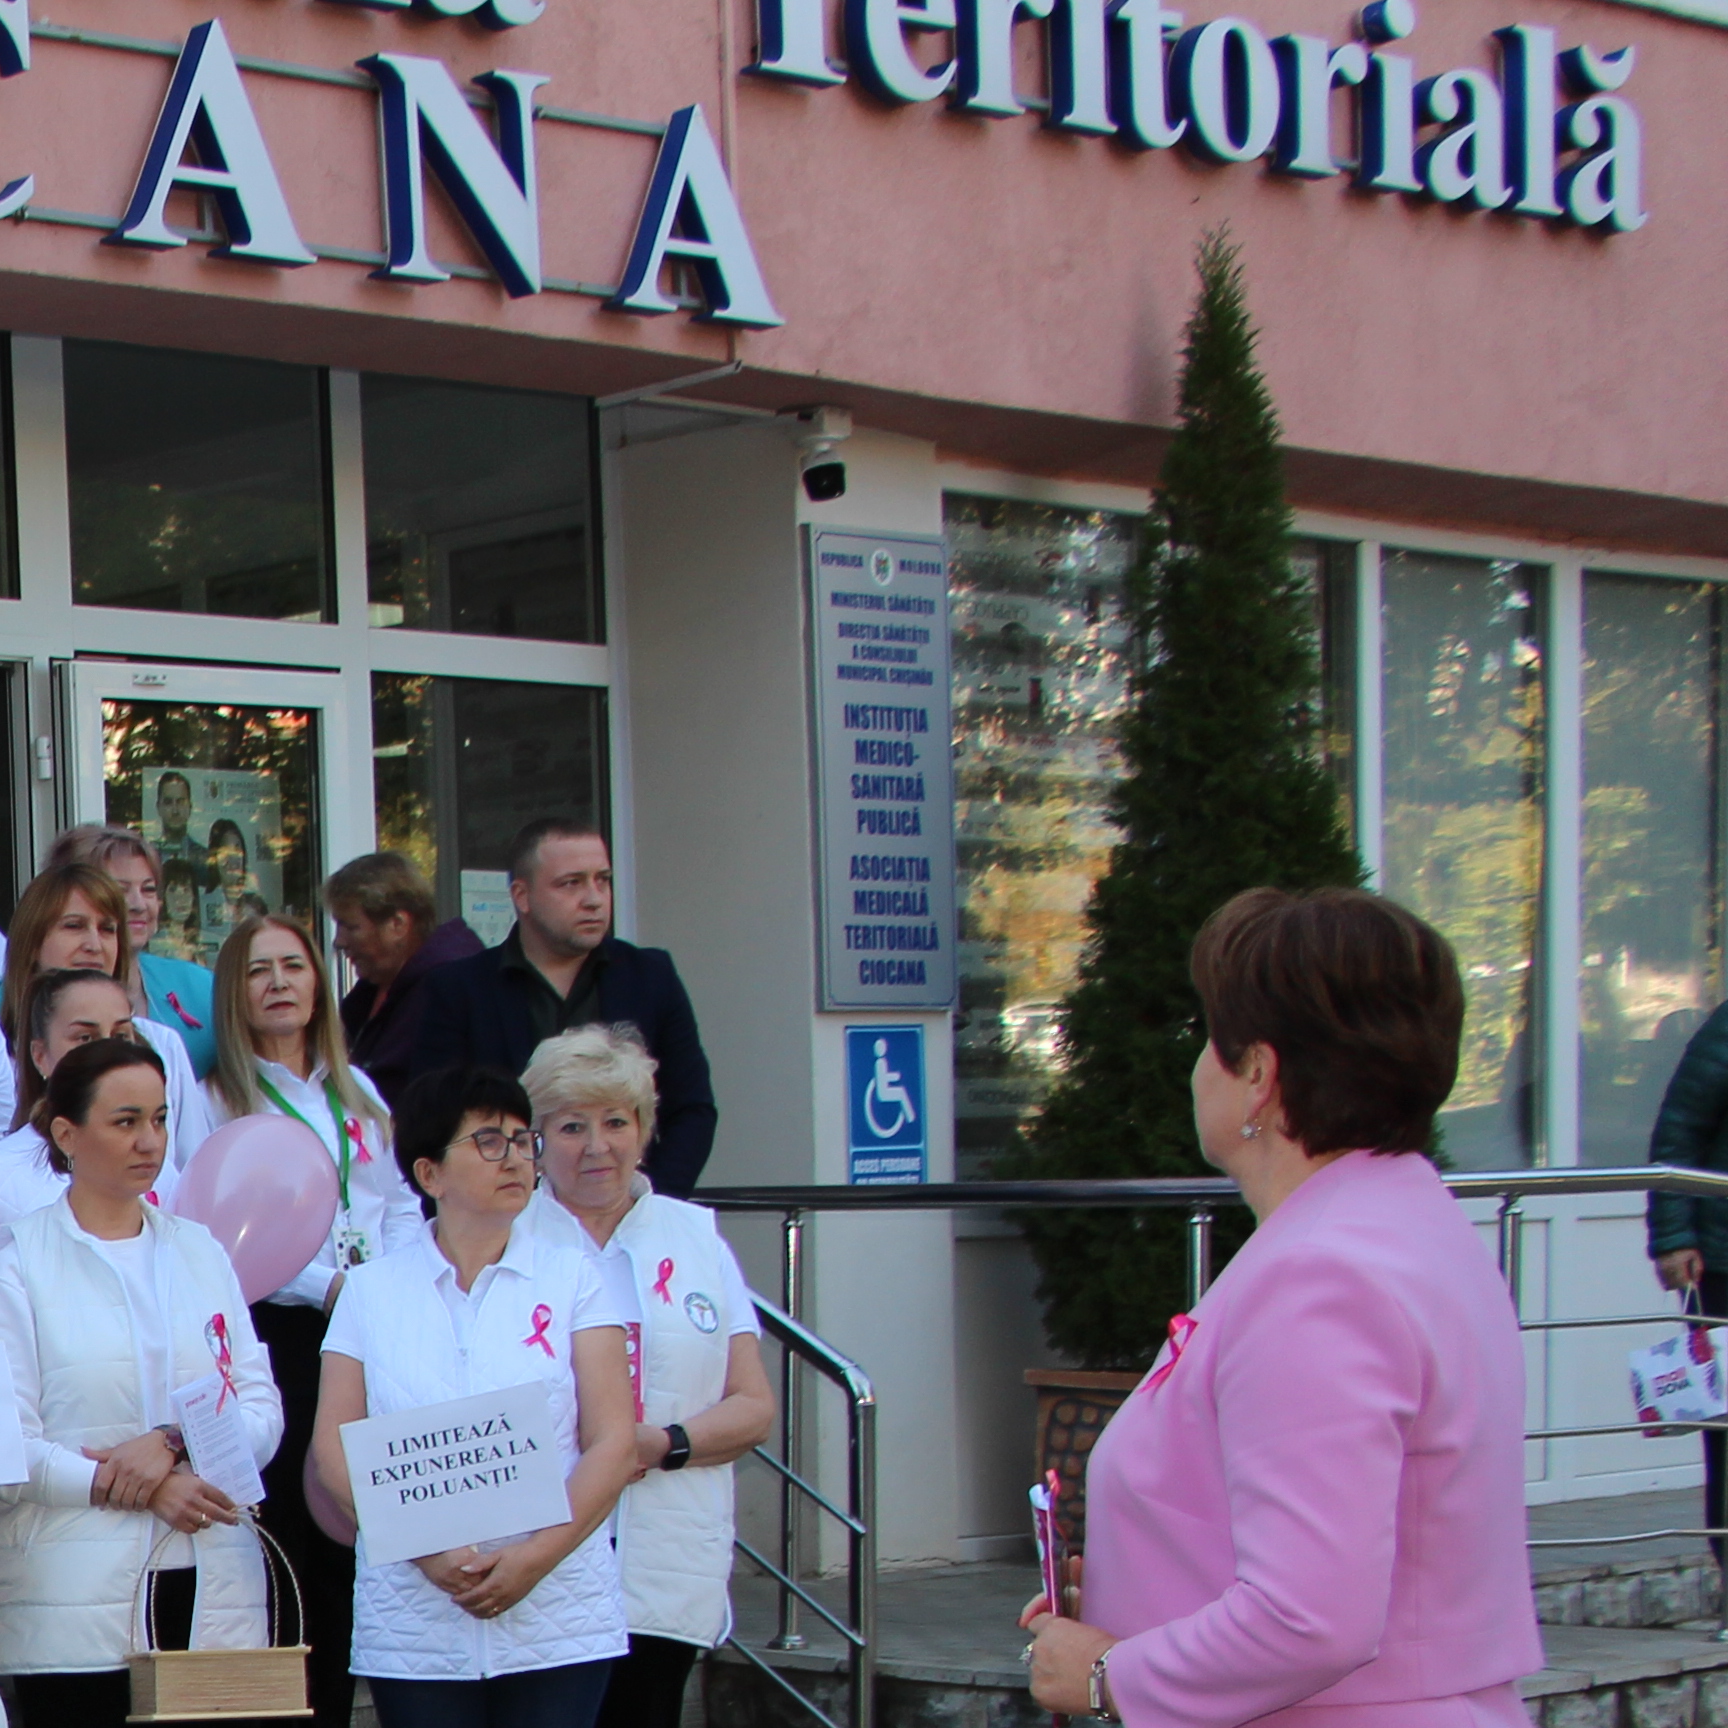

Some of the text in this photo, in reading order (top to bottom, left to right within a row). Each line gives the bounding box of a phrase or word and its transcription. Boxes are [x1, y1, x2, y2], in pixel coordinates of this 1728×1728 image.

[844, 703, 928, 738] INSTITUȚIA
[855, 739, 919, 767] MEDICO-
[851, 770, 925, 802] SANITARĂ
[857, 806, 921, 837] PUBLICĂ
[850, 854, 930, 889] ASOCIAȚIA
[853, 887, 929, 917] MEDICALĂ
[844, 920, 939, 952] TERITORIALĂ
[859, 959, 926, 986] CIOCANA
[386, 1413, 512, 1457] LIMITEAZĂ
[370, 1437, 538, 1486] EXPUNEREA LA
[399, 1465, 519, 1505] POLUANȚI!
